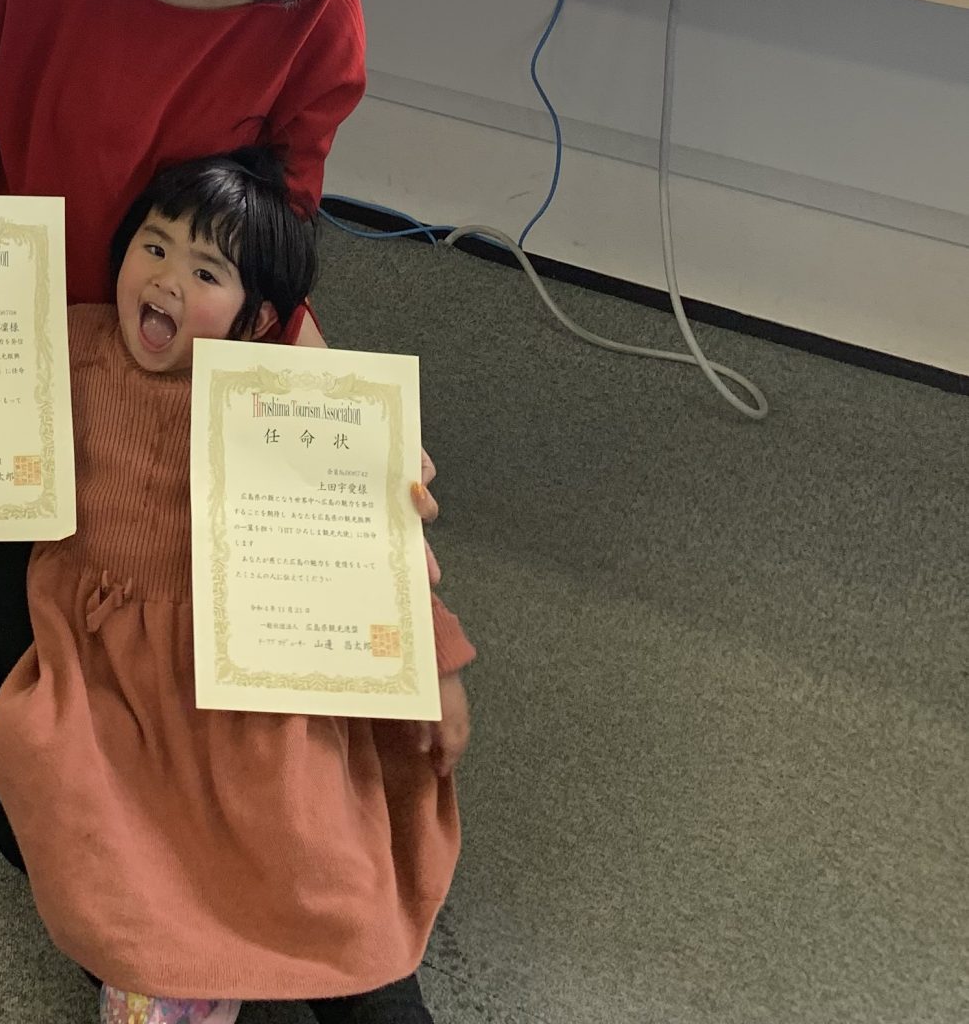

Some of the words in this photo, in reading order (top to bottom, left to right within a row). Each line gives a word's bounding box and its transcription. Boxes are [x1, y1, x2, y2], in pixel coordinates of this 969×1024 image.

[252, 392, 290, 418] Hiroshima
[290, 399, 321, 419] Tourism
[321, 402, 362, 426] Association
